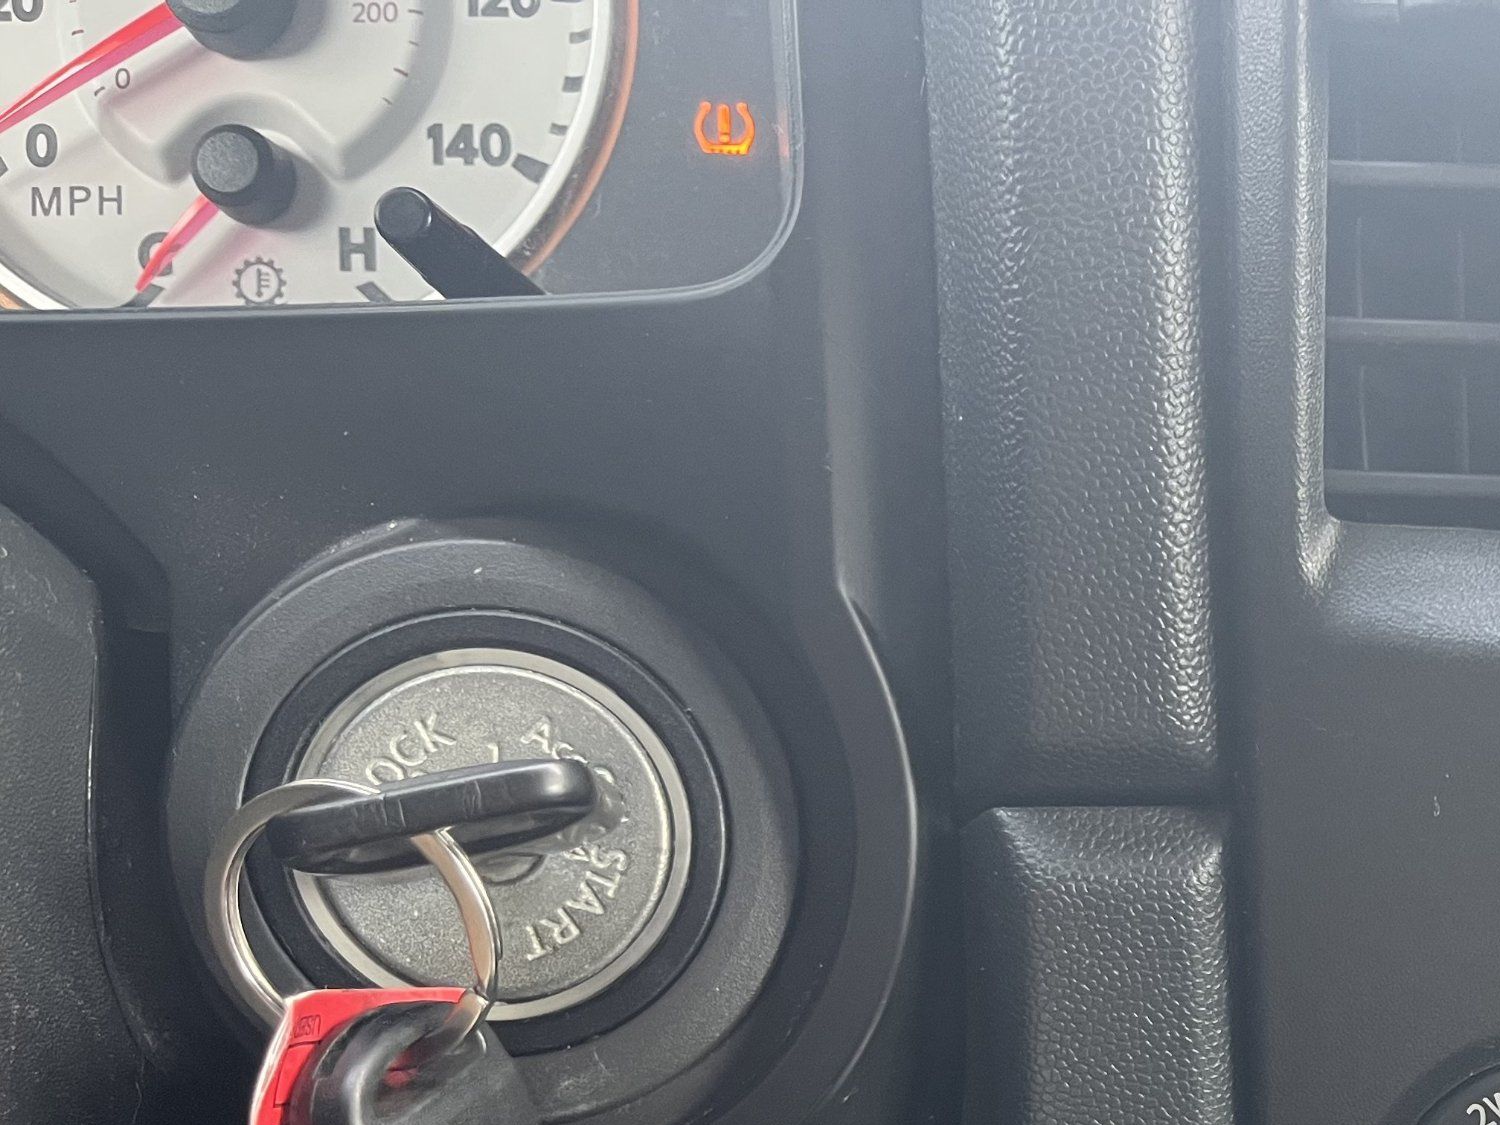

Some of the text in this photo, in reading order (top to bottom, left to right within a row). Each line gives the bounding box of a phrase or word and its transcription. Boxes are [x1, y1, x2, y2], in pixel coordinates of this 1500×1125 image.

[352, 2, 398, 23] 200
[115, 68, 131, 90] 0
[25, 124, 58, 167] 0
[426, 124, 512, 166] 140
[30, 186, 123, 217] MPH
[338, 227, 377, 271] H
[365, 712, 457, 786] OCK
[526, 845, 628, 961] START
